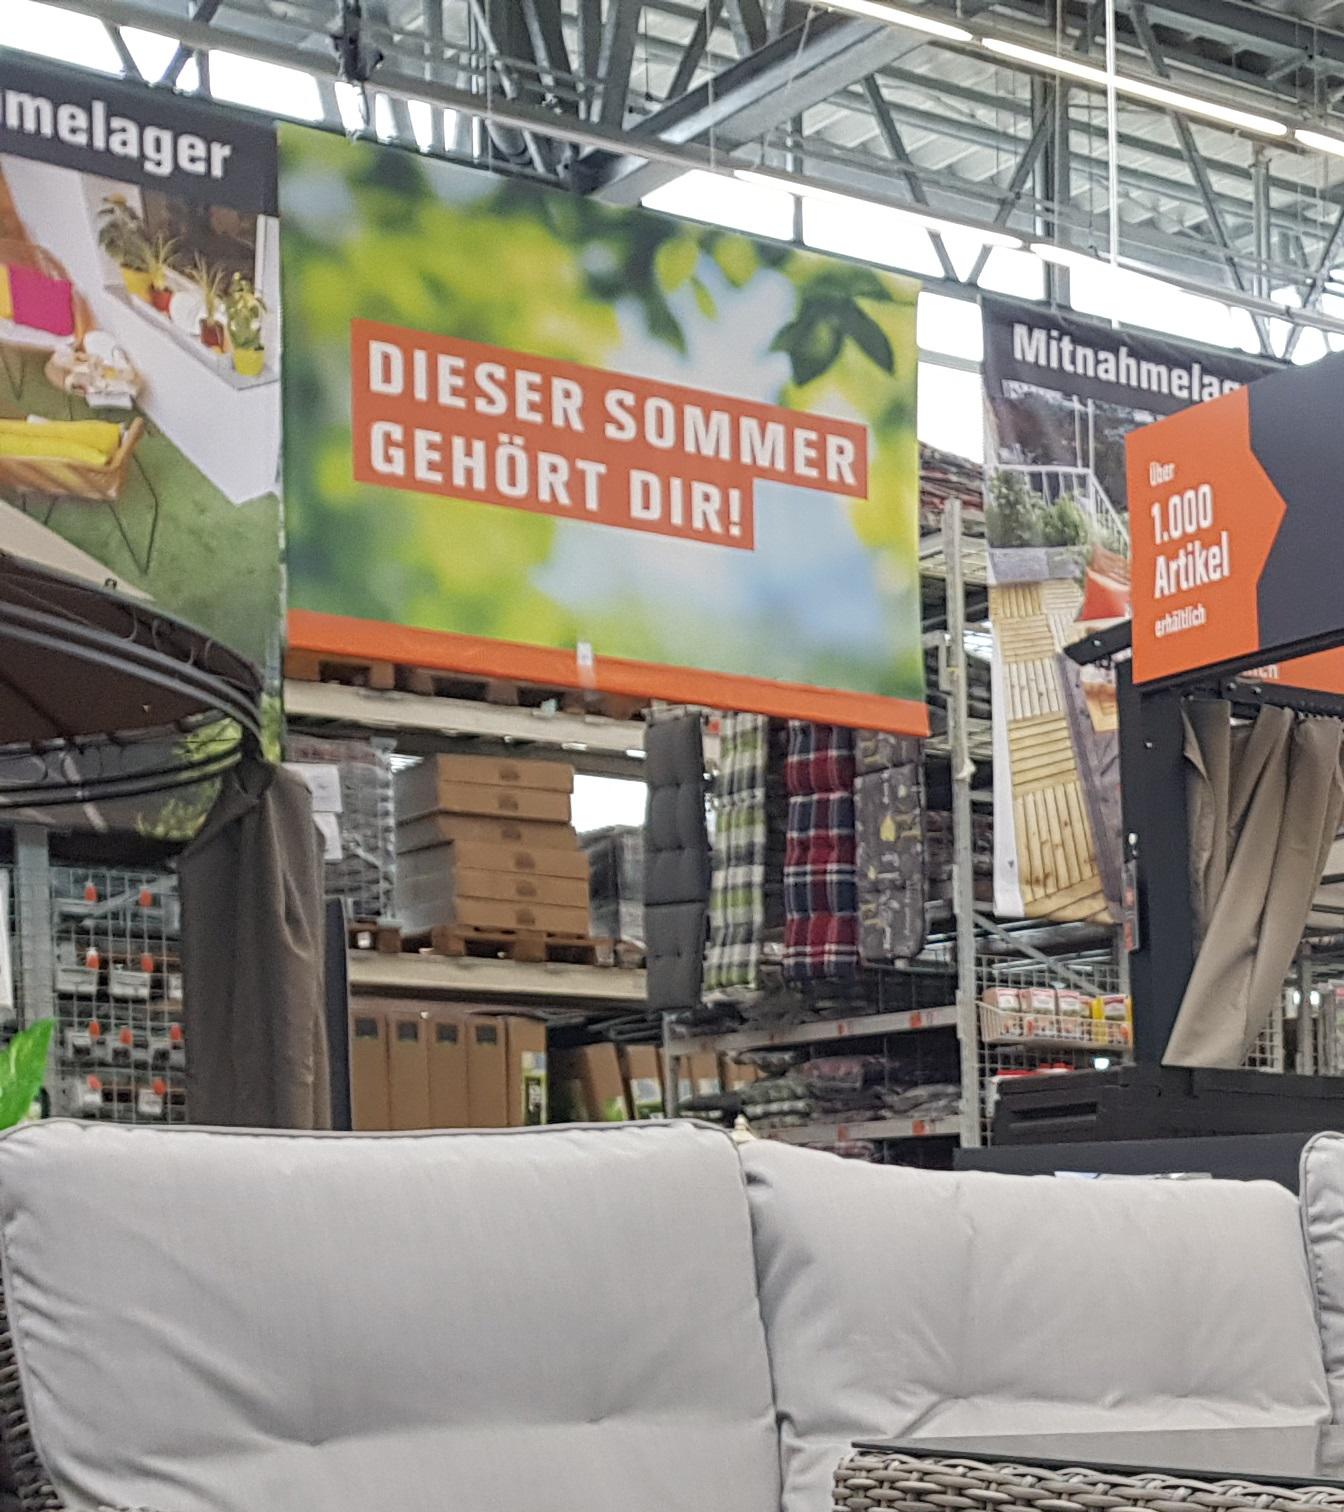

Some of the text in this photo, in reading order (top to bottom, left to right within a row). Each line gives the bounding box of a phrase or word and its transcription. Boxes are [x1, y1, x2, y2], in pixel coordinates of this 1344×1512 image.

[0, 89, 232, 179] melager
[368, 340, 857, 486] DIESER SOMMER
[370, 420, 742, 538] GEHÖRT DIR!
[1149, 461, 1175, 487] Über
[1151, 483, 1213, 545] 1.000
[1154, 530, 1230, 599] Artikel
[1155, 603, 1207, 638] erhältlich
